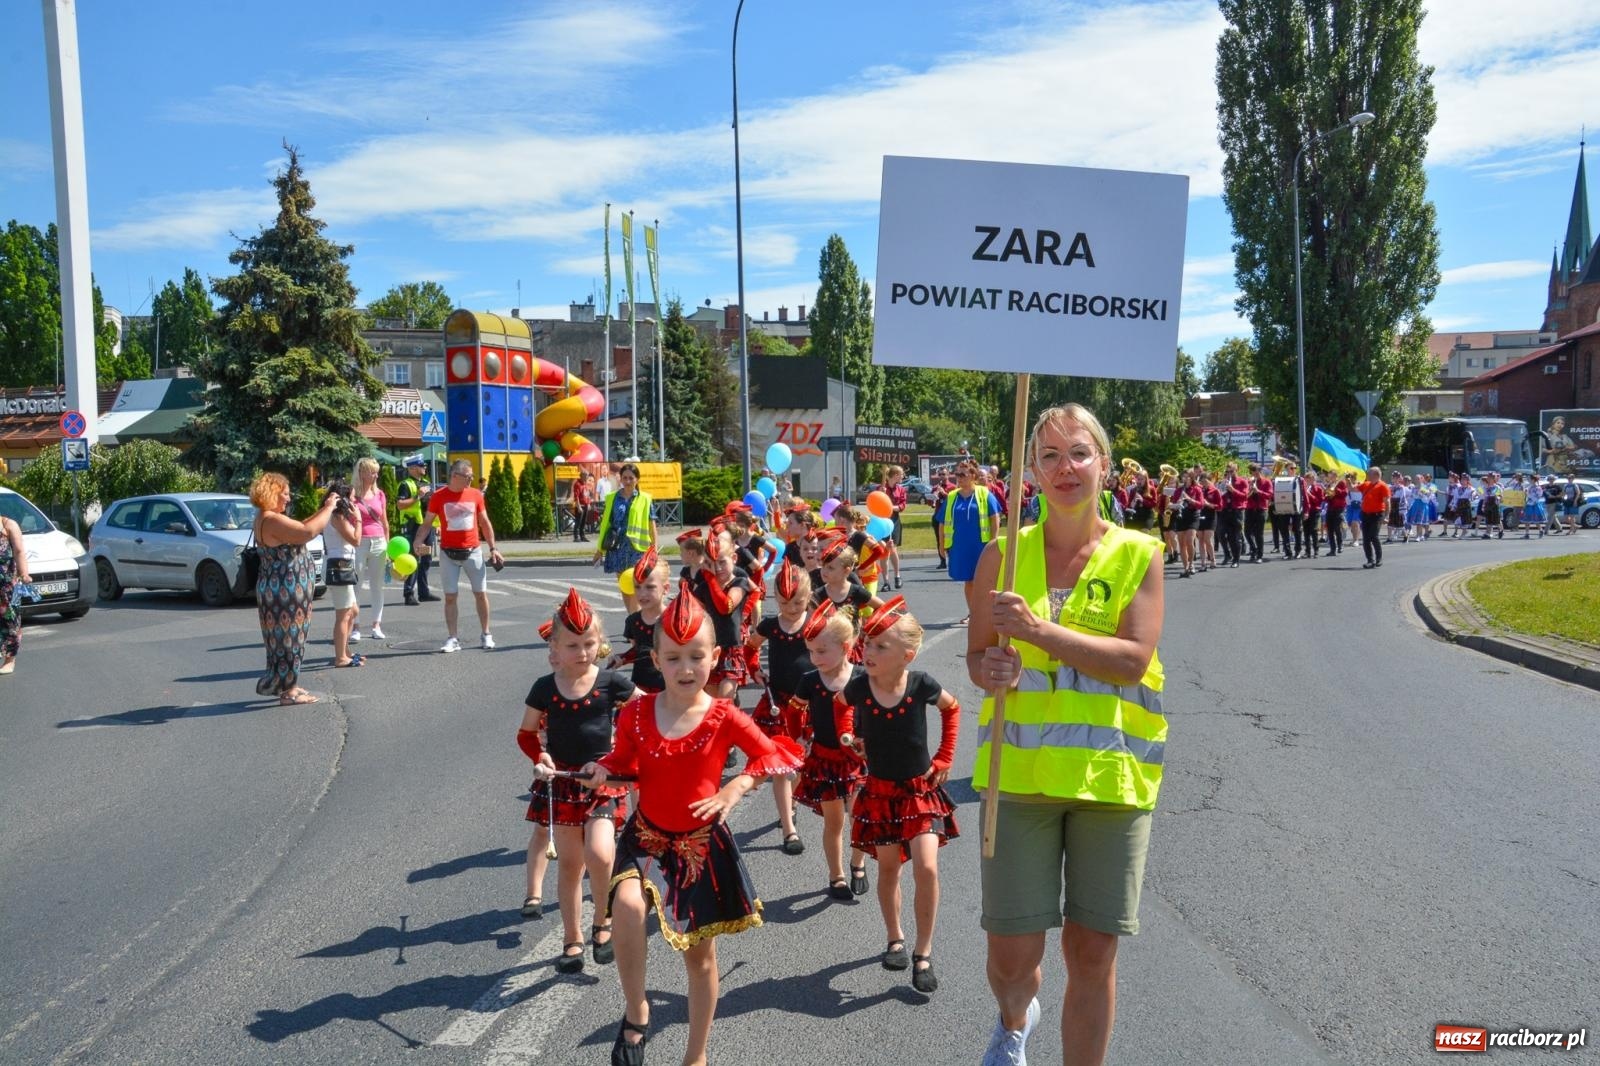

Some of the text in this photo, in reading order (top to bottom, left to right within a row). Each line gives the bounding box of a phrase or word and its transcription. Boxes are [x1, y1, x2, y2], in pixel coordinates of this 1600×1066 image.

[971, 225, 1096, 268] ZARA
[890, 283, 1168, 321] POWIAT RACIBORSKI
[855, 437, 896, 448] ORKIESTRA
[859, 447, 911, 464] Silenzio
